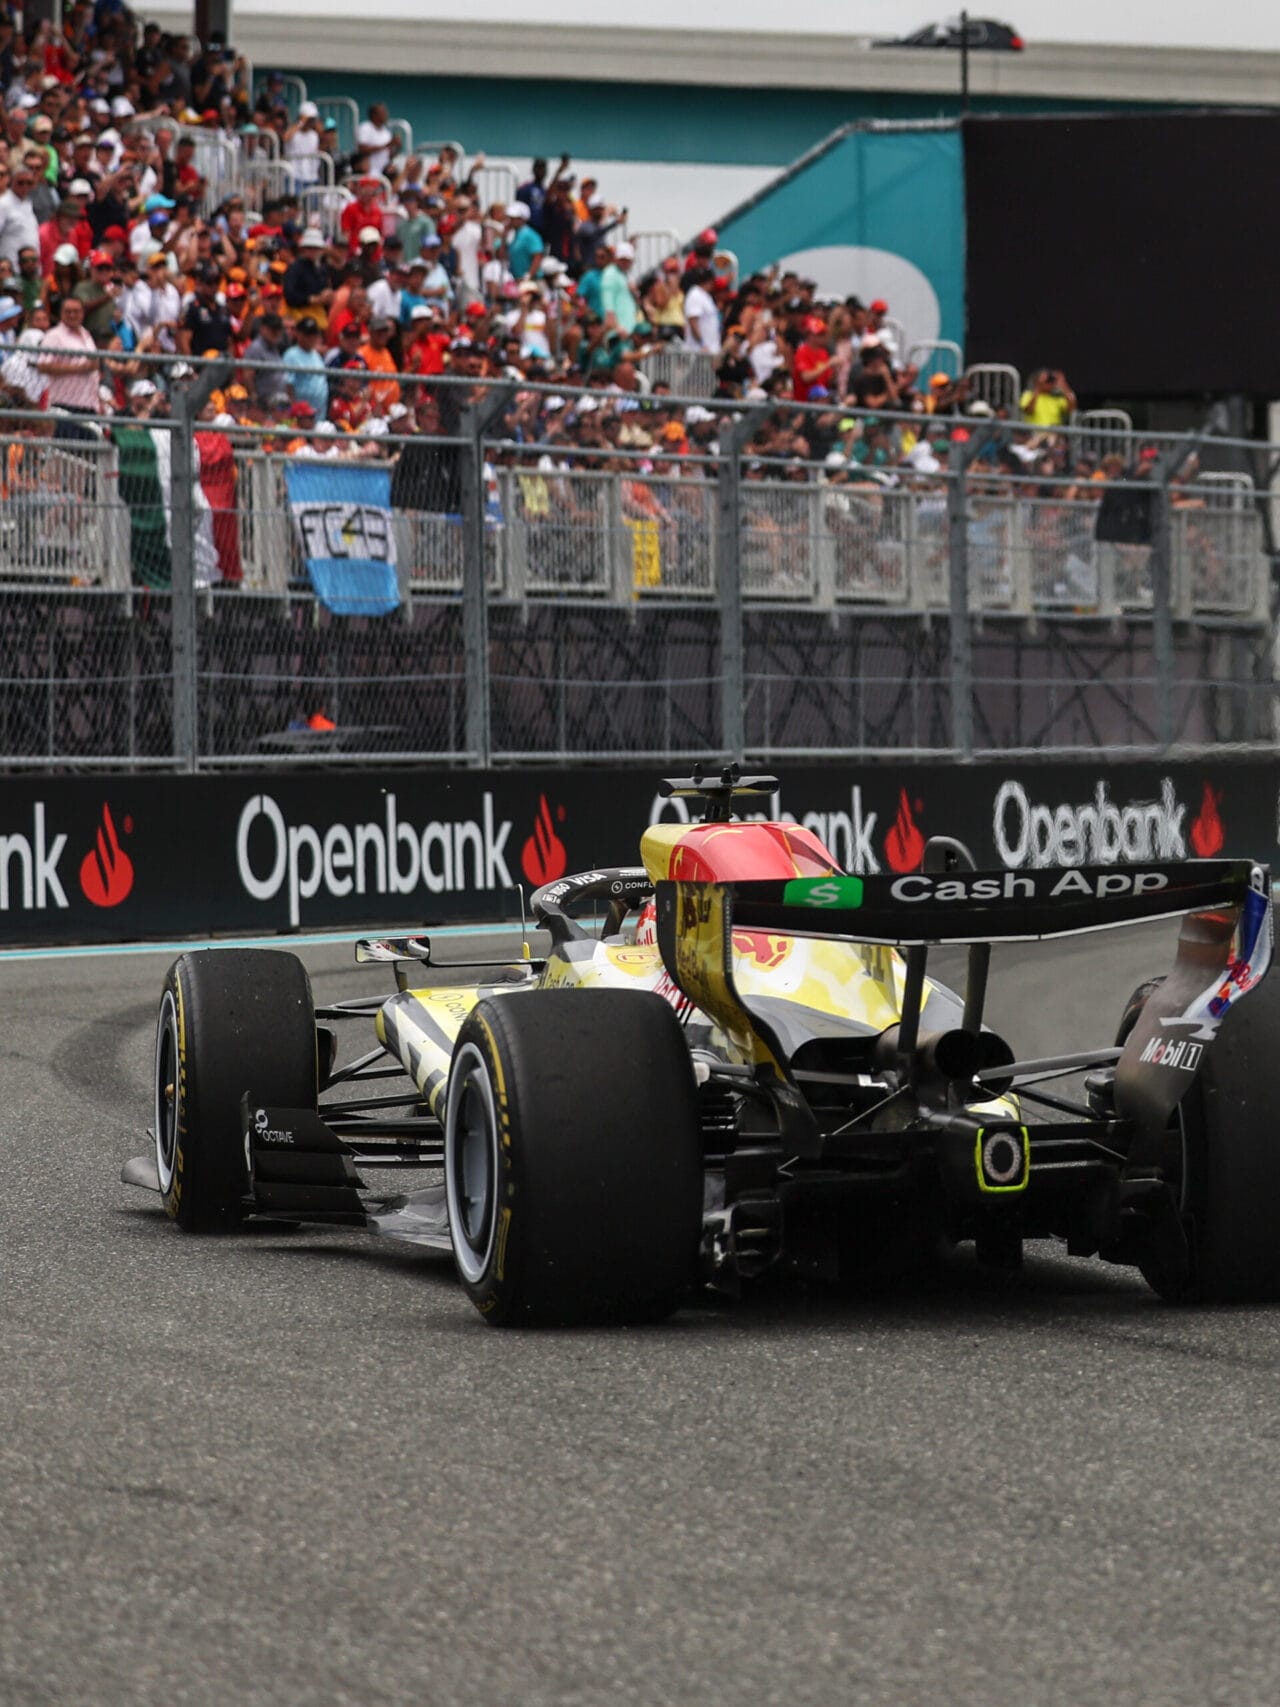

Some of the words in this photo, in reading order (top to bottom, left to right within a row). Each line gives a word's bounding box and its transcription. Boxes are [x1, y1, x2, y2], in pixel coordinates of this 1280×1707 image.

[992, 777, 1188, 869] Openbank
[237, 794, 514, 926] Openbank
[570, 873, 608, 886] VISA
[625, 881, 655, 889] CONFL
[891, 873, 1036, 901] Cash
[1049, 870, 1169, 899] App
[1139, 1037, 1187, 1067] Mobil
[263, 1130, 294, 1143] OCTAVE
